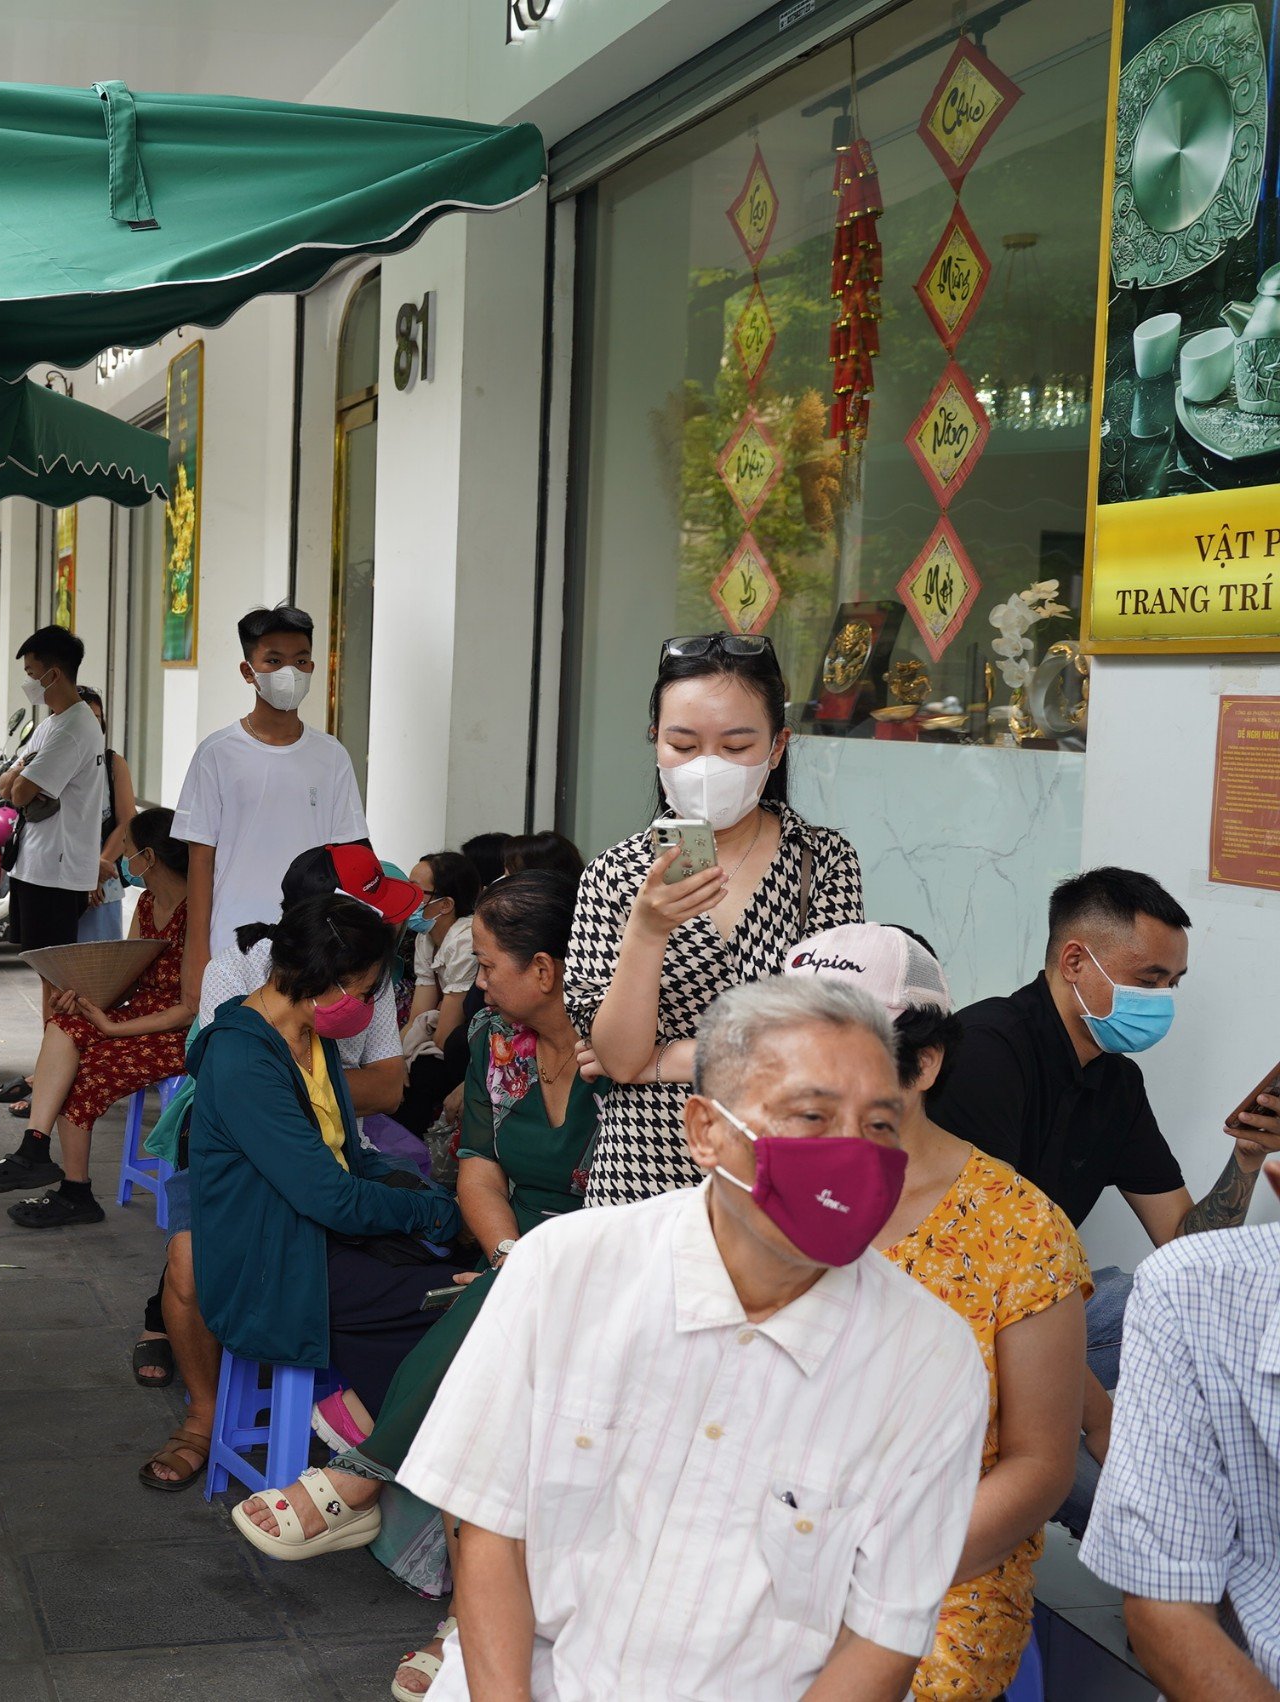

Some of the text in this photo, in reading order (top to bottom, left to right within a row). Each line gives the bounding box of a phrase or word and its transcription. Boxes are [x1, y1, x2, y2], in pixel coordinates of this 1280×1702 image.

[394, 291, 436, 392] 81
[932, 406, 969, 459] Năm
[1194, 523, 1255, 569] VẬT
[1115, 572, 1274, 616] TRANG TRÍ
